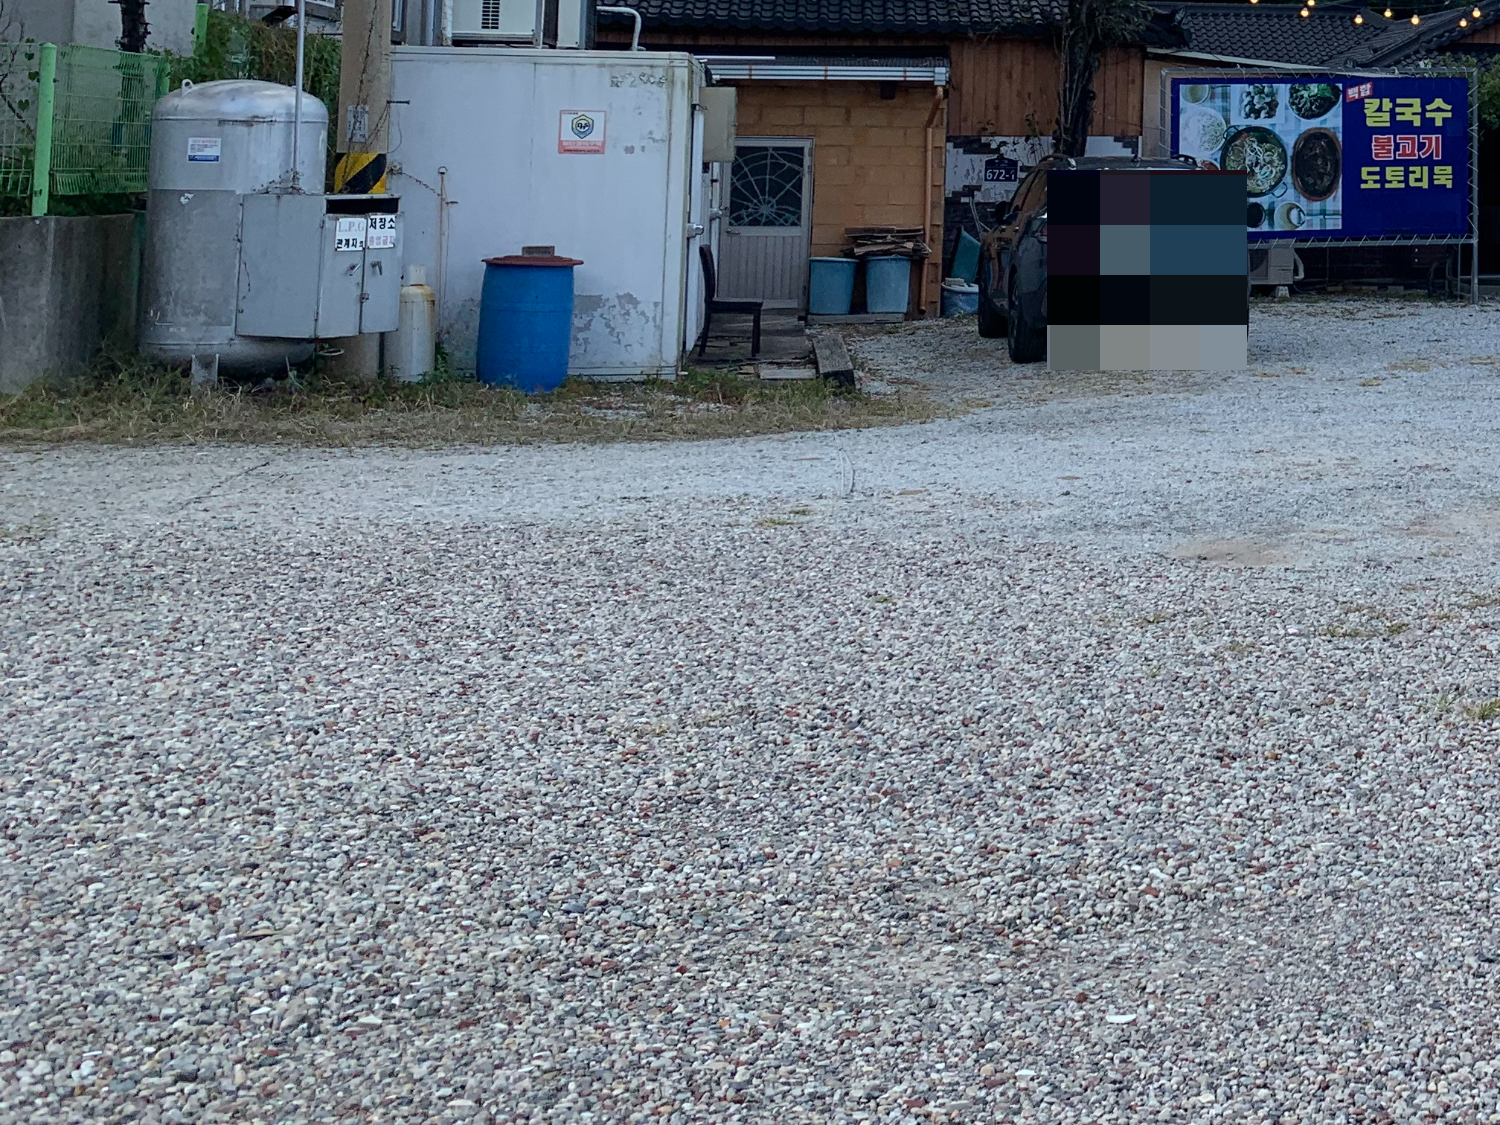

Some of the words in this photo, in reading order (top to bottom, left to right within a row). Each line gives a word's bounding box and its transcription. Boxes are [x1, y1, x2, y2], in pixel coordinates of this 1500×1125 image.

[1348, 83, 1371, 99] 백합
[1363, 98, 1452, 127] 칼국수
[1372, 135, 1441, 160] 불고기
[1360, 166, 1453, 189] 도토리묵
[338, 221, 364, 232] L.P.G
[369, 217, 395, 230] 저장소
